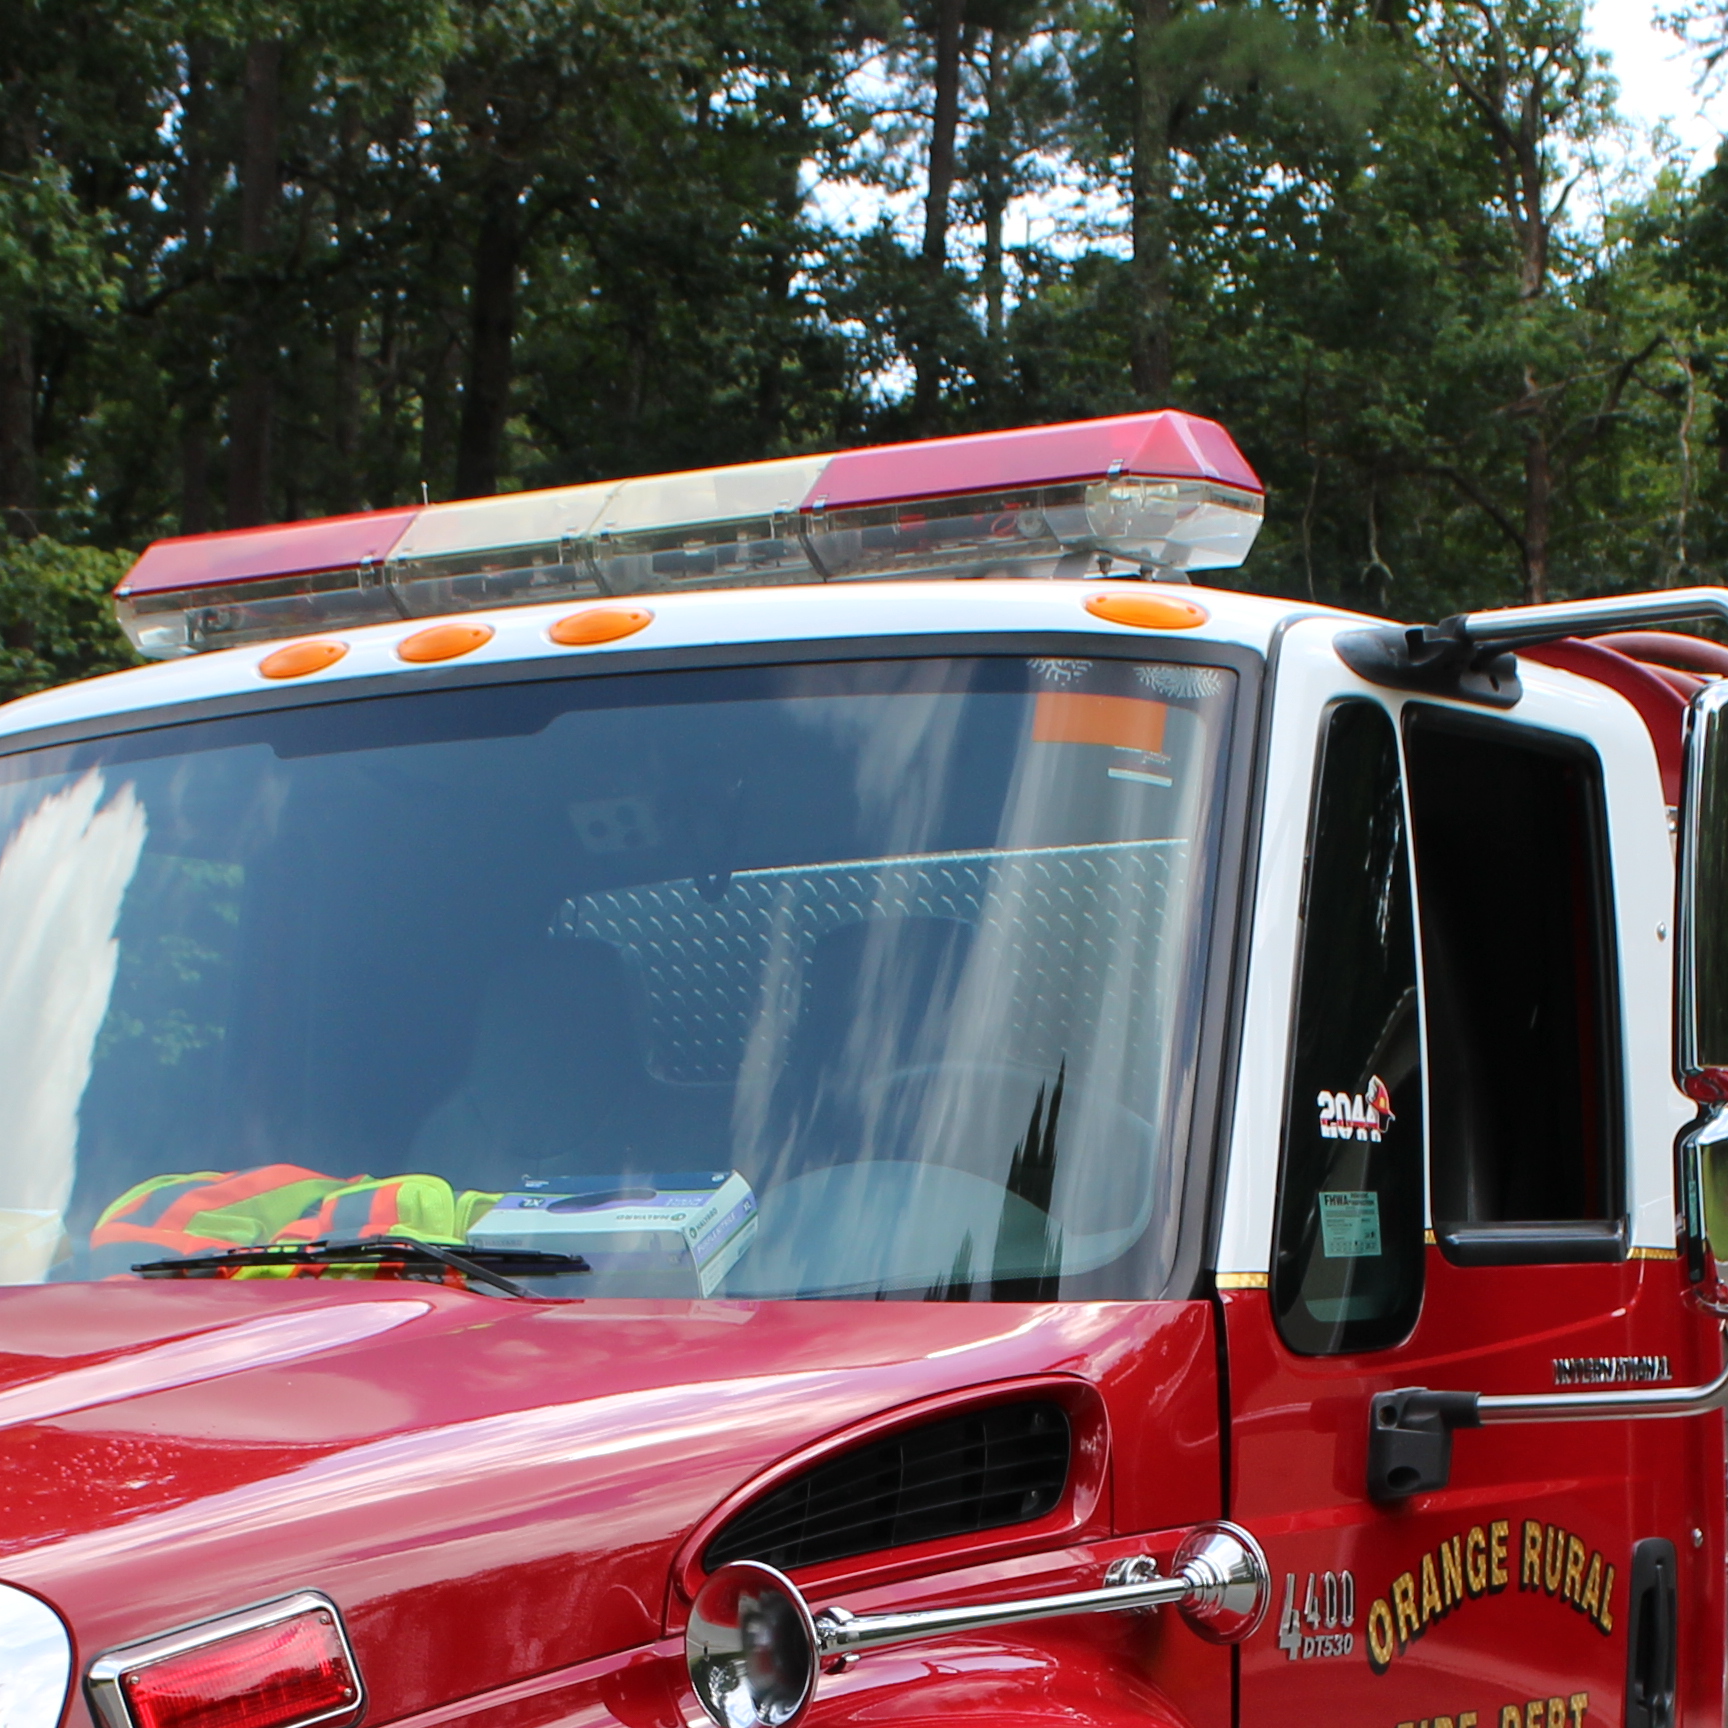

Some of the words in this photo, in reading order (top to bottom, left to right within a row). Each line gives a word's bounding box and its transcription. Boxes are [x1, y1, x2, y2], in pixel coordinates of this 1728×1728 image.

[1552, 1355, 1673, 1386] INTERNATIONAL
[1278, 1570, 1355, 1661] 4400
[1367, 1519, 1510, 1672] ORANGE
[1521, 1519, 1614, 1634] RURAL
[1303, 1633, 1354, 1660] DT530
